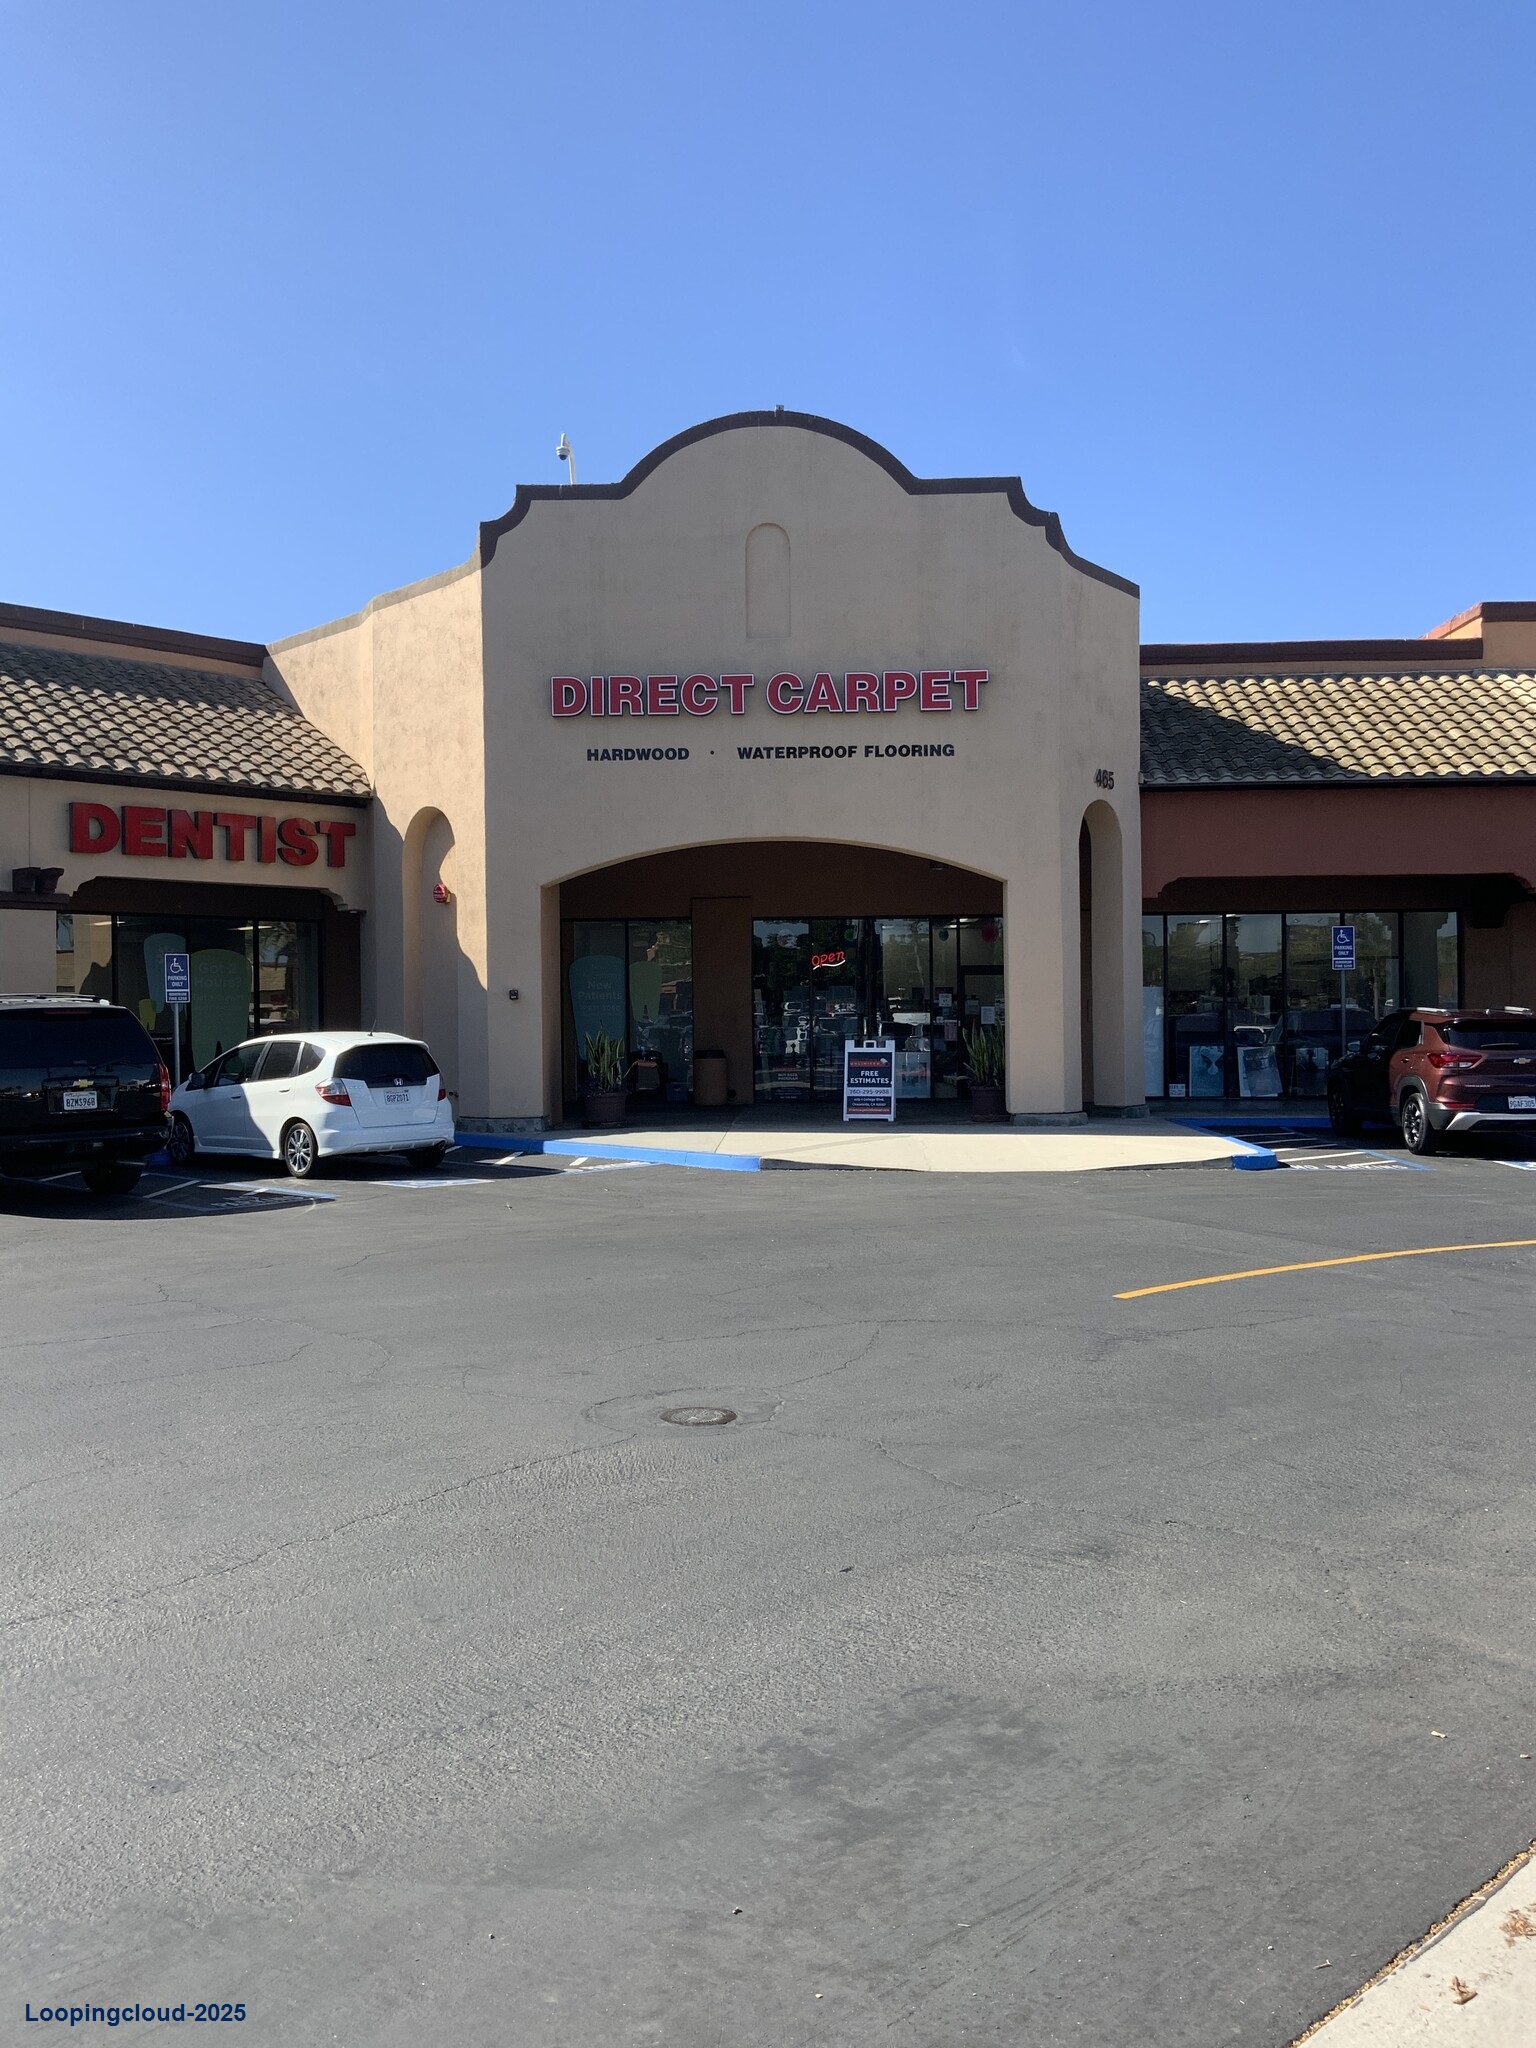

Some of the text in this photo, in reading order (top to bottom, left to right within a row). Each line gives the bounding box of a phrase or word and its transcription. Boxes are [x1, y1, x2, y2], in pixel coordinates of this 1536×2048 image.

[551, 669, 990, 717] DIRECT CARPET
[586, 744, 956, 762] HARDWOOD WATERPROOF FLOORING
[1094, 768, 1115, 790] 465
[69, 802, 356, 868] DENTIST
[811, 951, 846, 968] Open
[66, 1098, 96, 1107] 8ZMS968
